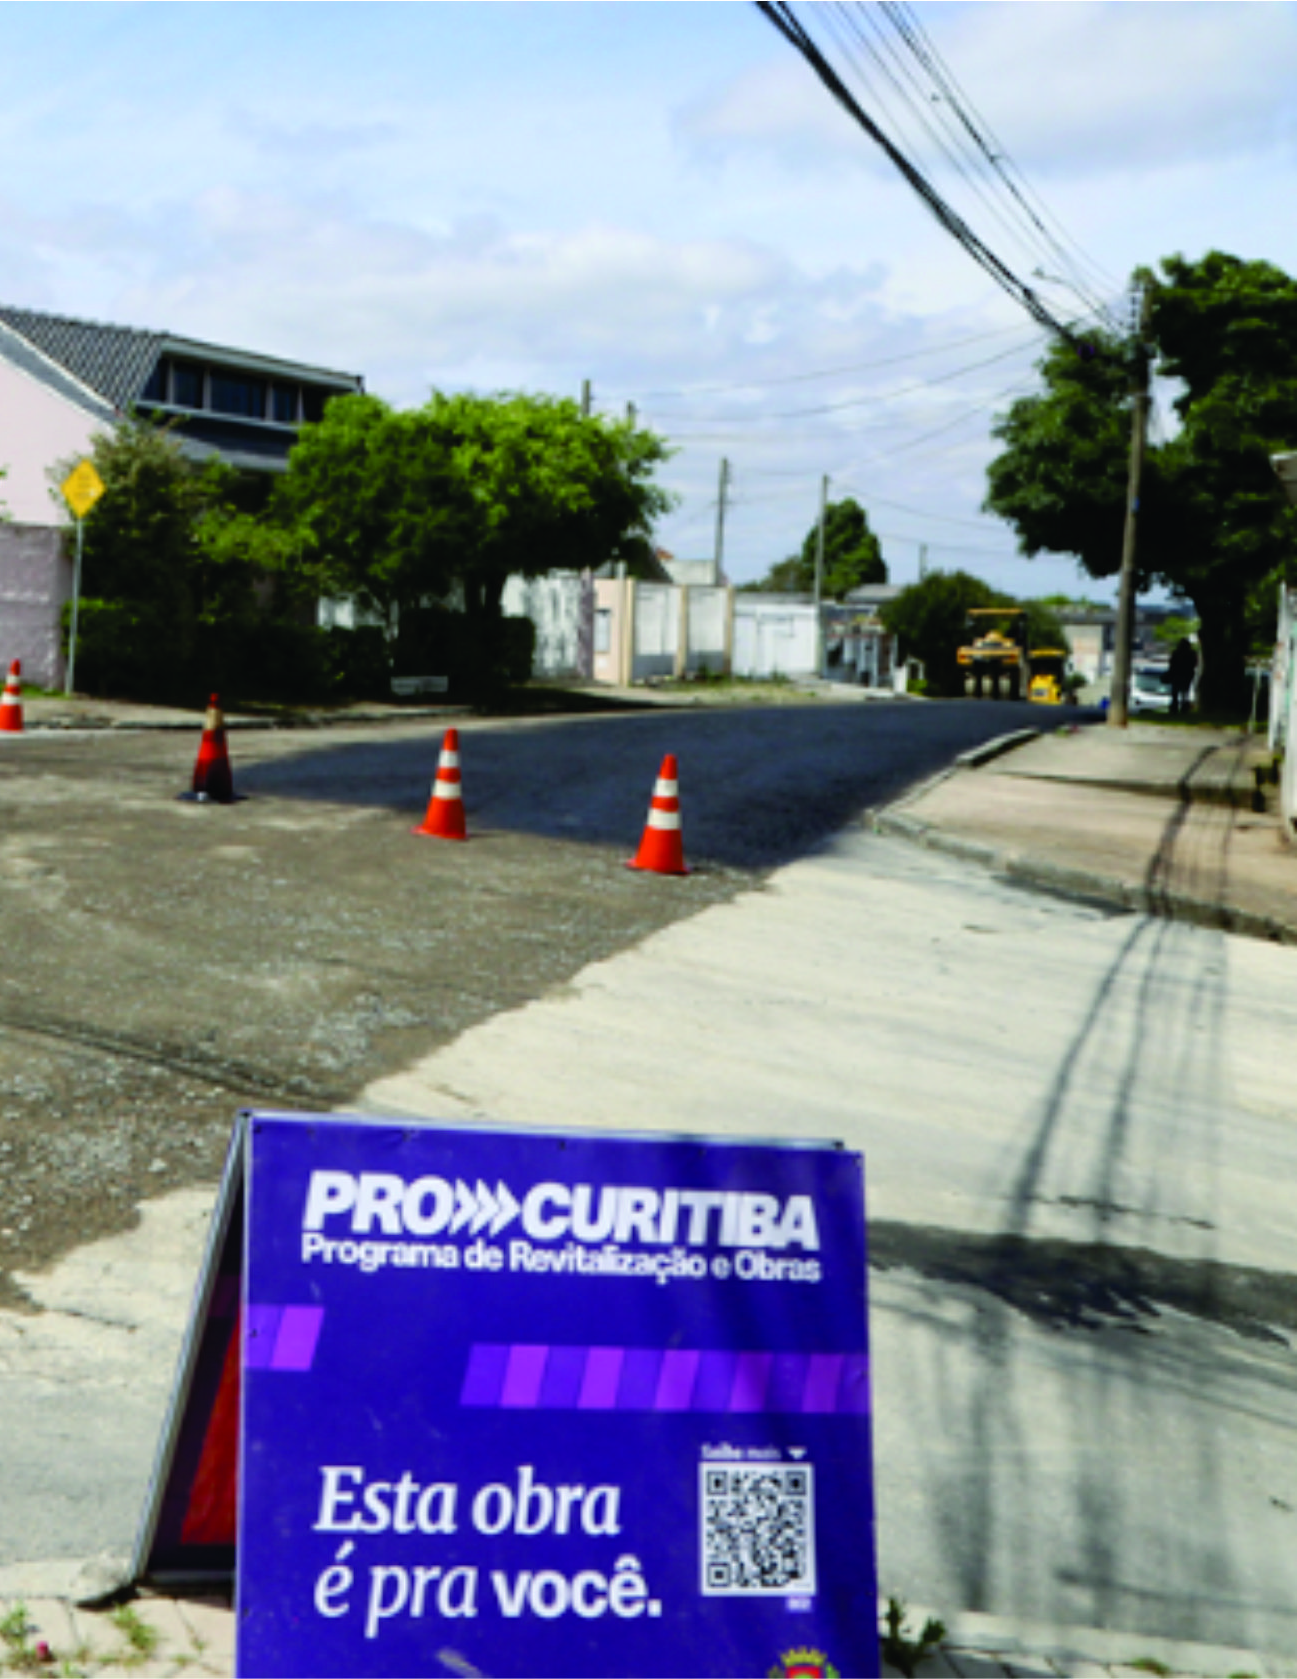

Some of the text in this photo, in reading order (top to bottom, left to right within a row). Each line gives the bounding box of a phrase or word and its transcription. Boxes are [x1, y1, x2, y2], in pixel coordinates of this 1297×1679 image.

[301, 1231, 822, 1285] Programa de Revitalização e Obras
[312, 1463, 622, 1536] Esta obra
[314, 1539, 663, 1639] é pra você.
